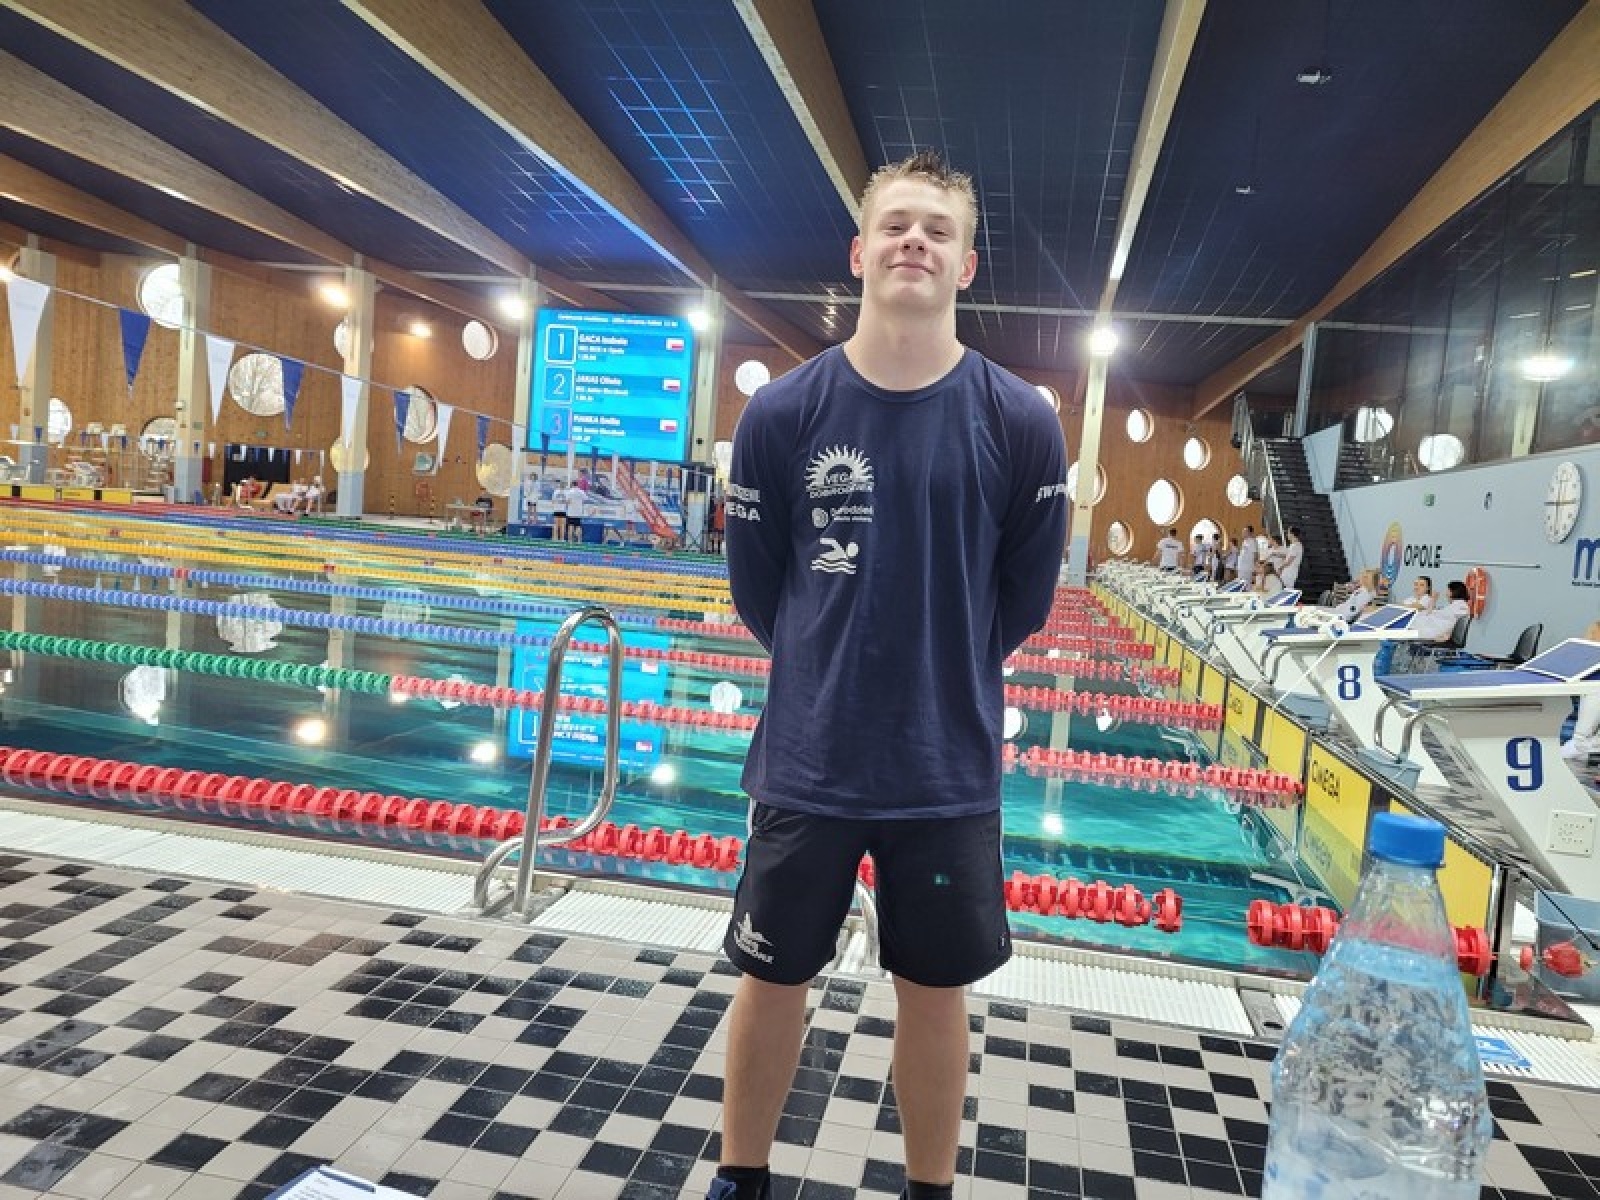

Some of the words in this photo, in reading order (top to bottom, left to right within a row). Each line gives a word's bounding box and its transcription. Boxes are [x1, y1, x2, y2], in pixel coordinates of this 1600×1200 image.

[558, 333, 565, 355] 1
[553, 373, 565, 395] 2
[551, 413, 563, 435] 3
[1404, 543, 1442, 568] OPOLE
[1337, 665, 1362, 701] 8
[1506, 737, 1544, 791] 9
[1311, 760, 1341, 804] OMEGA
